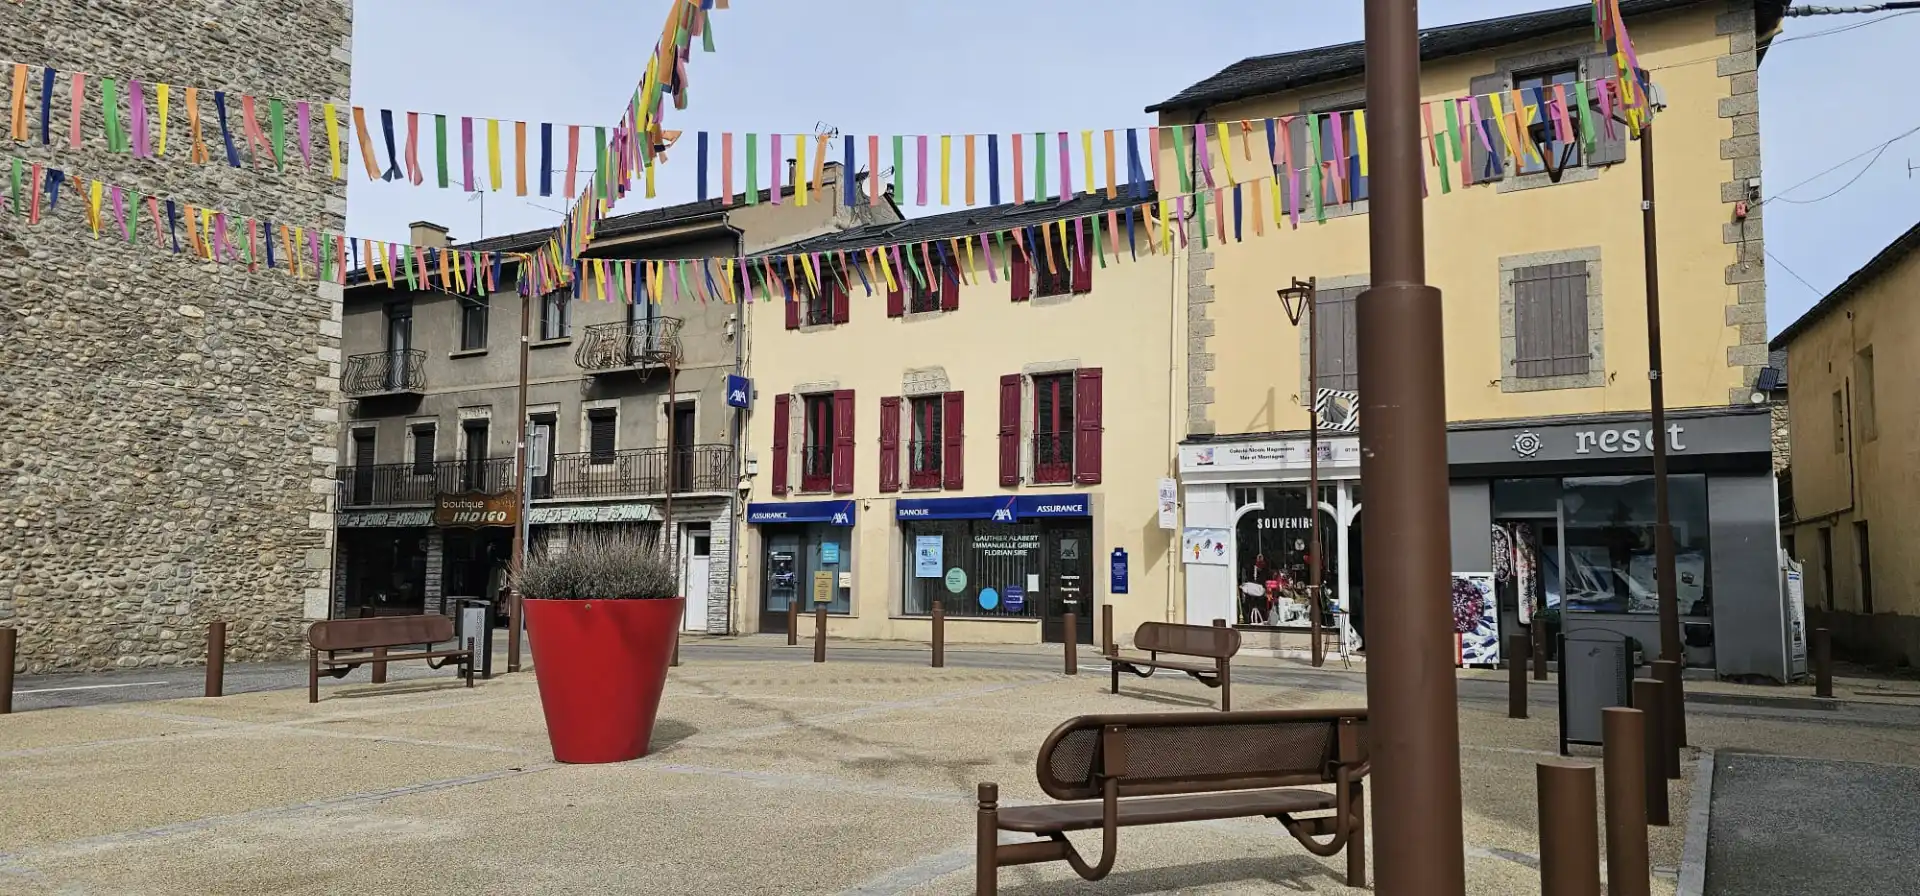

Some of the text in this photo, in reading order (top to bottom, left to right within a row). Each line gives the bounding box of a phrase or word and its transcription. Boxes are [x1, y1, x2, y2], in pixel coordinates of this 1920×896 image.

[729, 389, 747, 403] AXA
[442, 496, 485, 512] boutique
[1036, 504, 1083, 513] ASSURANCE
[452, 510, 507, 522] INDIGO
[751, 512, 788, 520] ASSURANCE
[831, 512, 849, 523] AXA
[899, 508, 929, 516] BANQUE
[991, 508, 1012, 521] AXA
[972, 541, 1016, 549] EMMANUELLE
